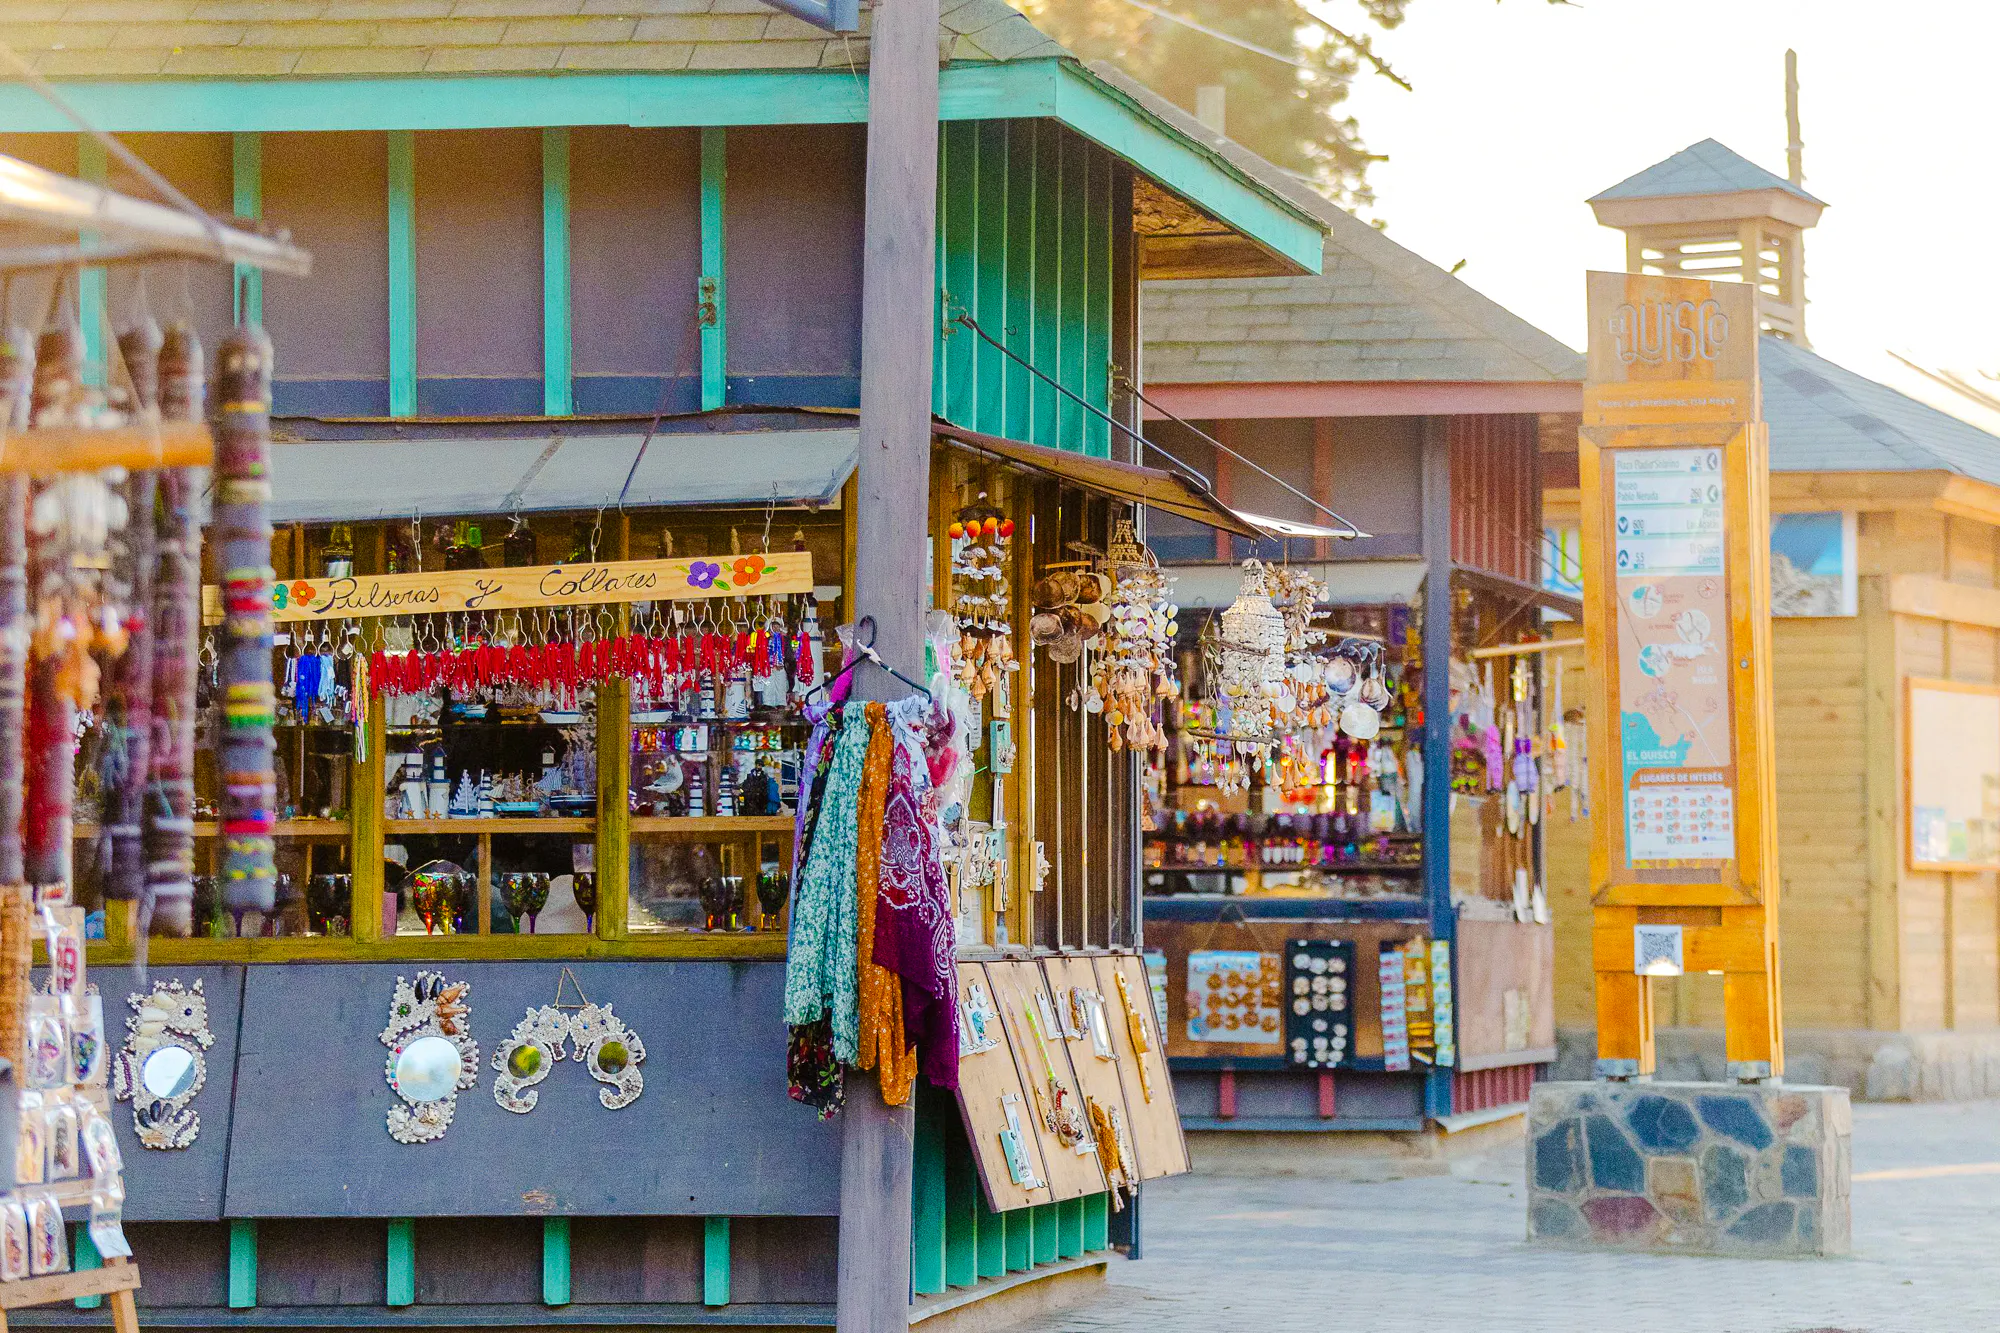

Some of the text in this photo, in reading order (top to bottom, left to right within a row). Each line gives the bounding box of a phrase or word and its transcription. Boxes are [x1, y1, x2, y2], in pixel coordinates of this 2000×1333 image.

[312, 577, 440, 615] Pulseras
[540, 567, 657, 597] Collares
[1626, 749, 1677, 760] EL QUISCO
[1639, 773, 1675, 783] LUGARES
[1677, 772, 1689, 782] DE
